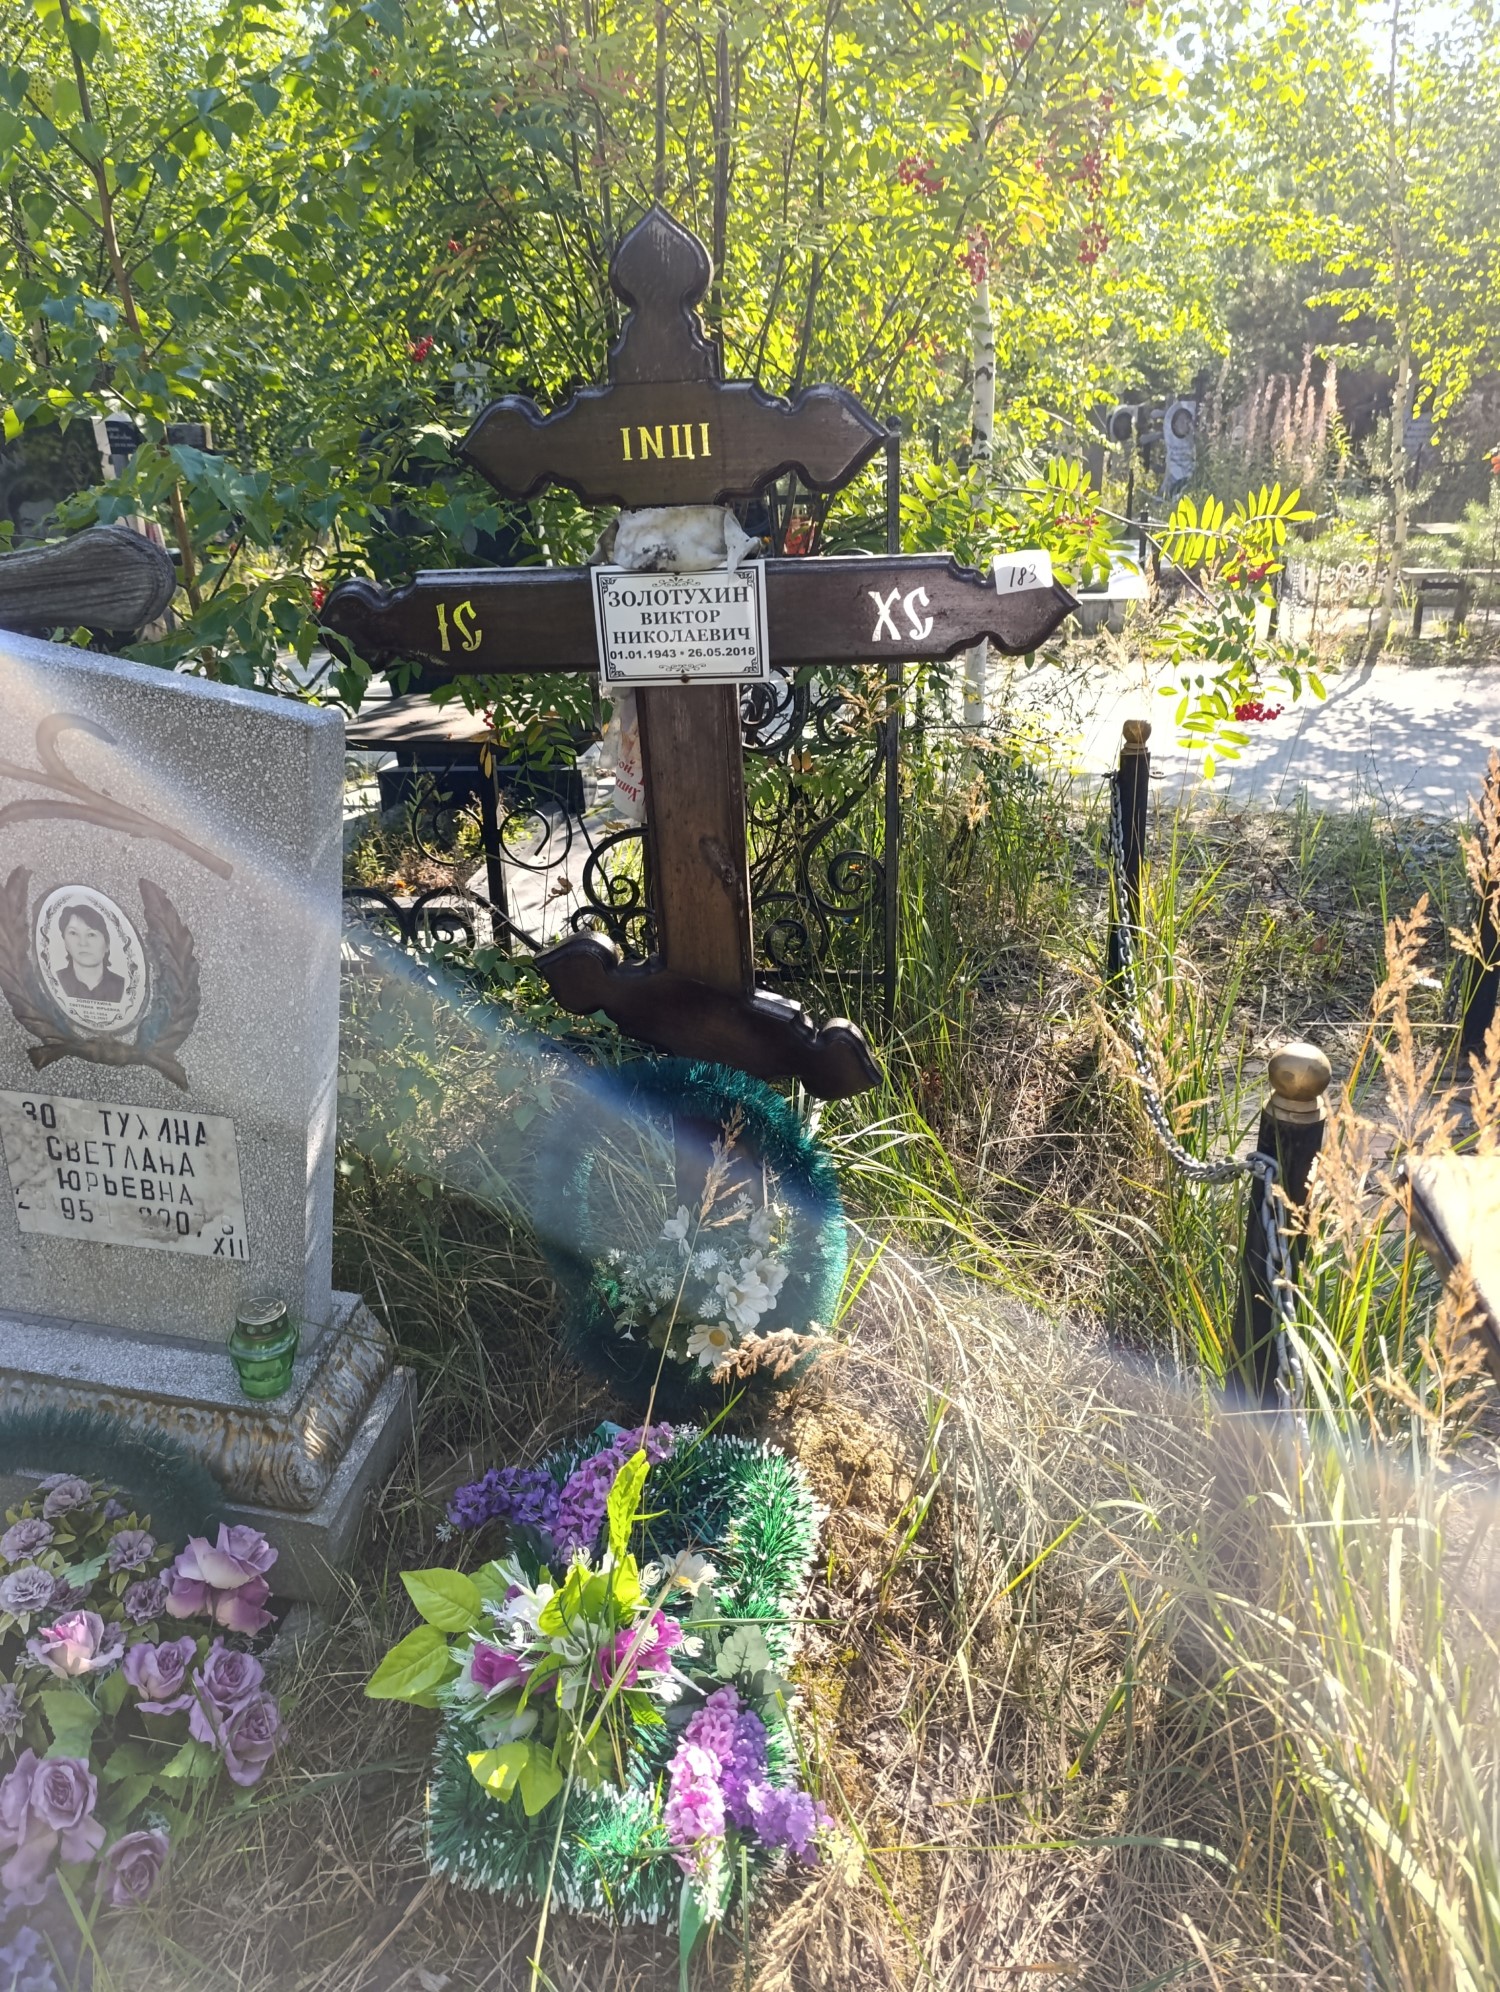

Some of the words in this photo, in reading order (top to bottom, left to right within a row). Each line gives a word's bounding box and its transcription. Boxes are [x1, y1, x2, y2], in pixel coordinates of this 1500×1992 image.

[1009, 563, 1037, 588] 183
[608, 586, 750, 608] ЗОЛОТУХИН
[640, 609, 721, 626] ВИКТОР
[613, 627, 751, 645] НИКОЛАЕВИЧ
[610, 650, 677, 660] 01.01.1943
[688, 647, 756, 658] 26.05.2018
[46, 1136, 196, 1178] СВЕТЛАНА
[57, 1168, 194, 1206] ЮРЬЕВНА
